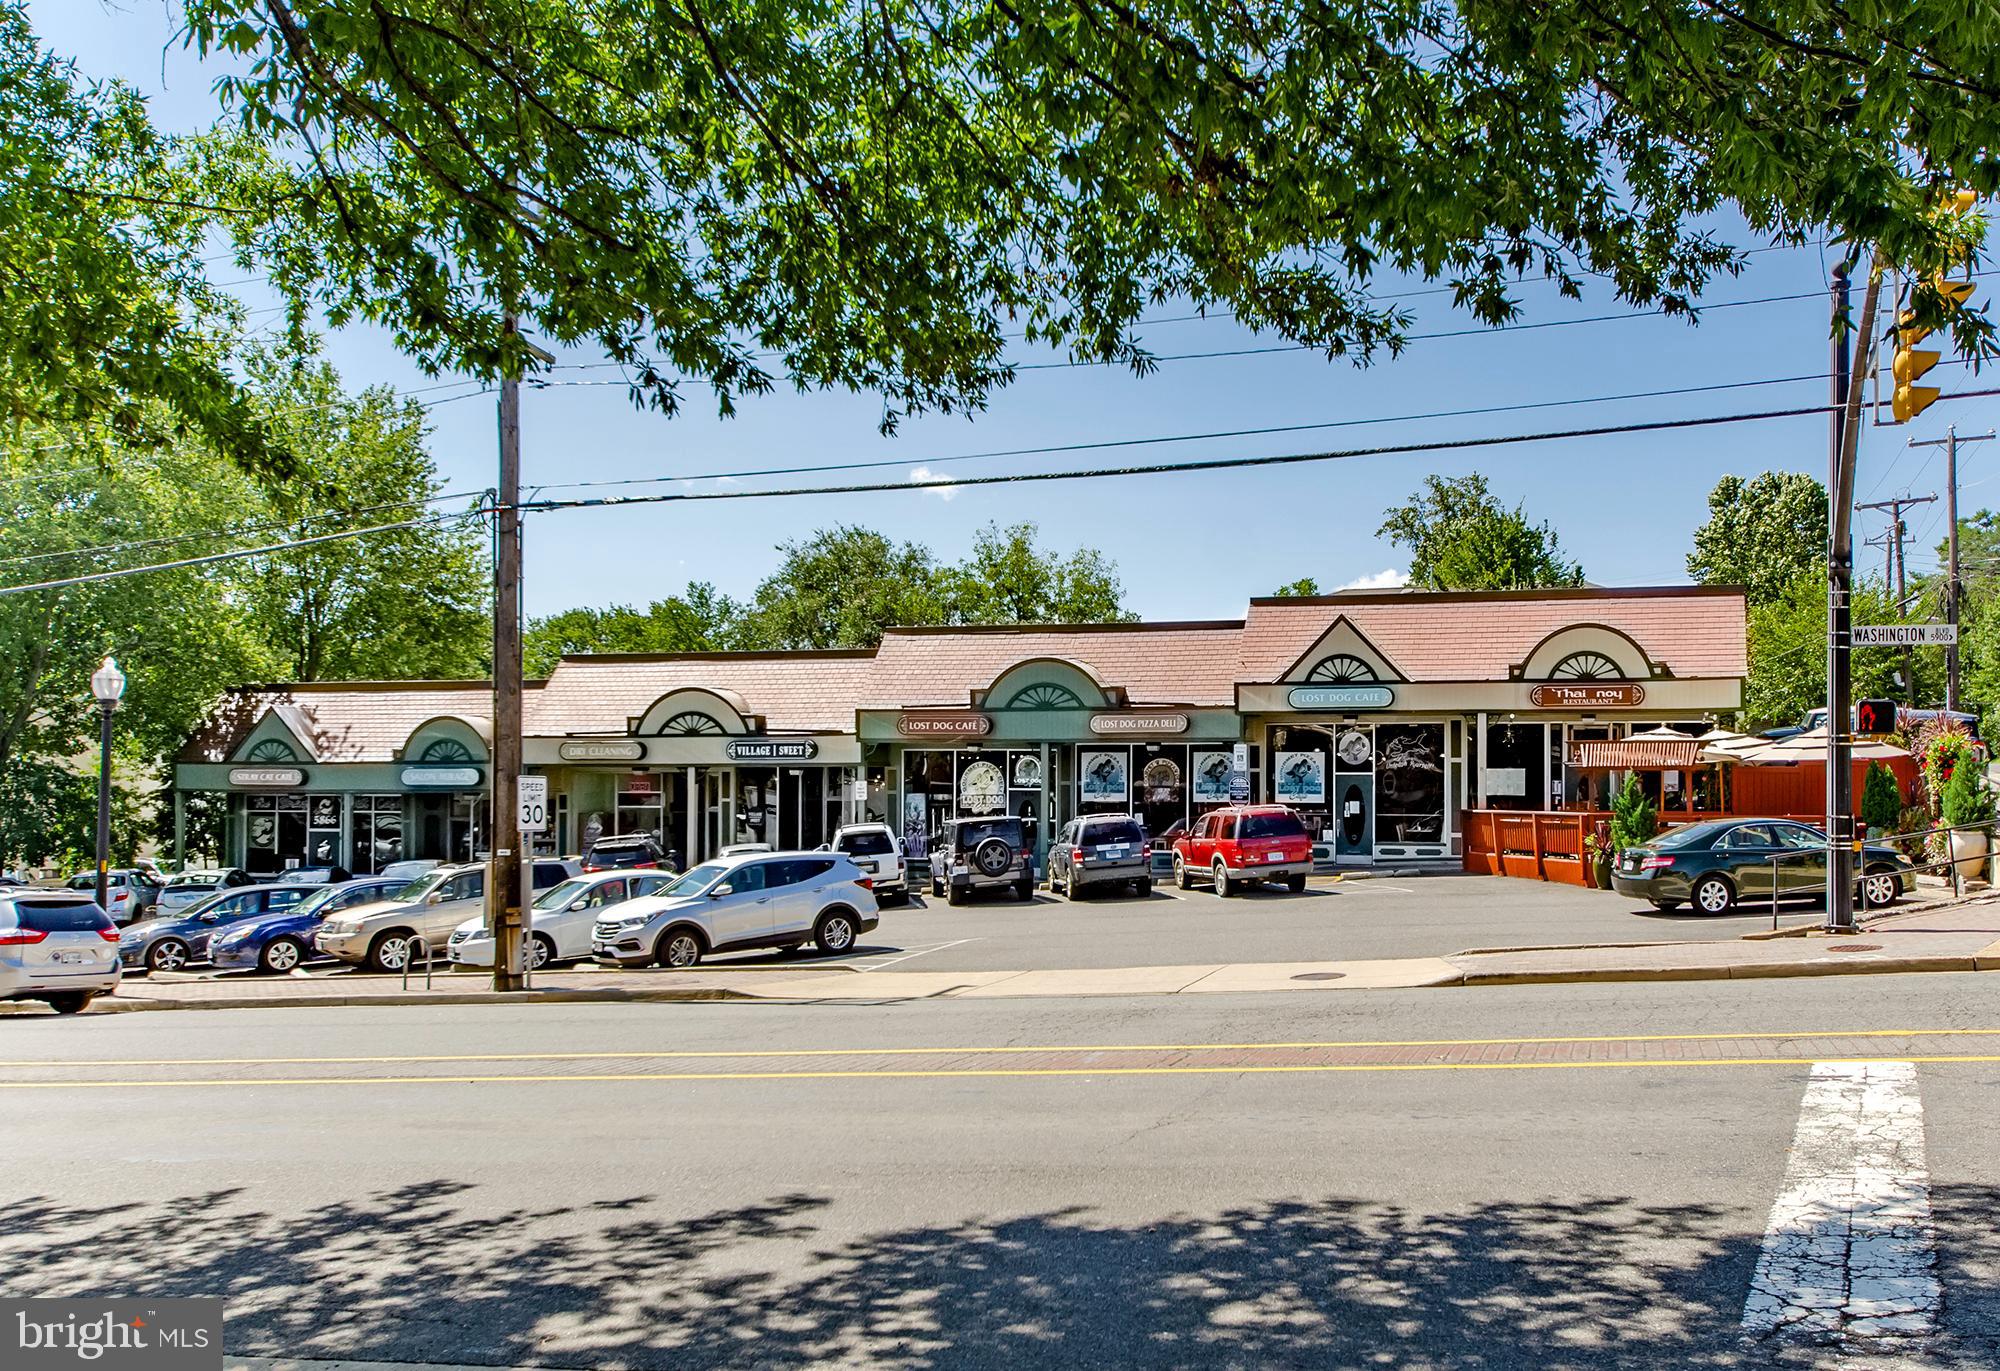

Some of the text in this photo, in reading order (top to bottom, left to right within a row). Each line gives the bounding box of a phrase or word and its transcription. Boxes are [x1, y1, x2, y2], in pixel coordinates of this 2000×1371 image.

[1854, 628, 1925, 642] WASHINGTON
[1931, 633, 1948, 641] 5900
[1301, 694, 1324, 702] LOST
[1329, 694, 1351, 702] DOG
[1552, 688, 1622, 700] Thai noy
[909, 719, 978, 730] LOST DOG CAFÉ
[1101, 719, 1176, 728] LOST DOG PIZZA DELI
[569, 746, 632, 756] DRY CLEANING
[737, 745, 804, 756] VILLAGE SWEET
[260, 773, 274, 781] CAT
[521, 782, 544, 791] SPEED
[523, 793, 542, 802] LIMIT
[962, 795, 1004, 803] LOST DOG
[521, 804, 543, 824] 30
[313, 815, 337, 824] 5866
